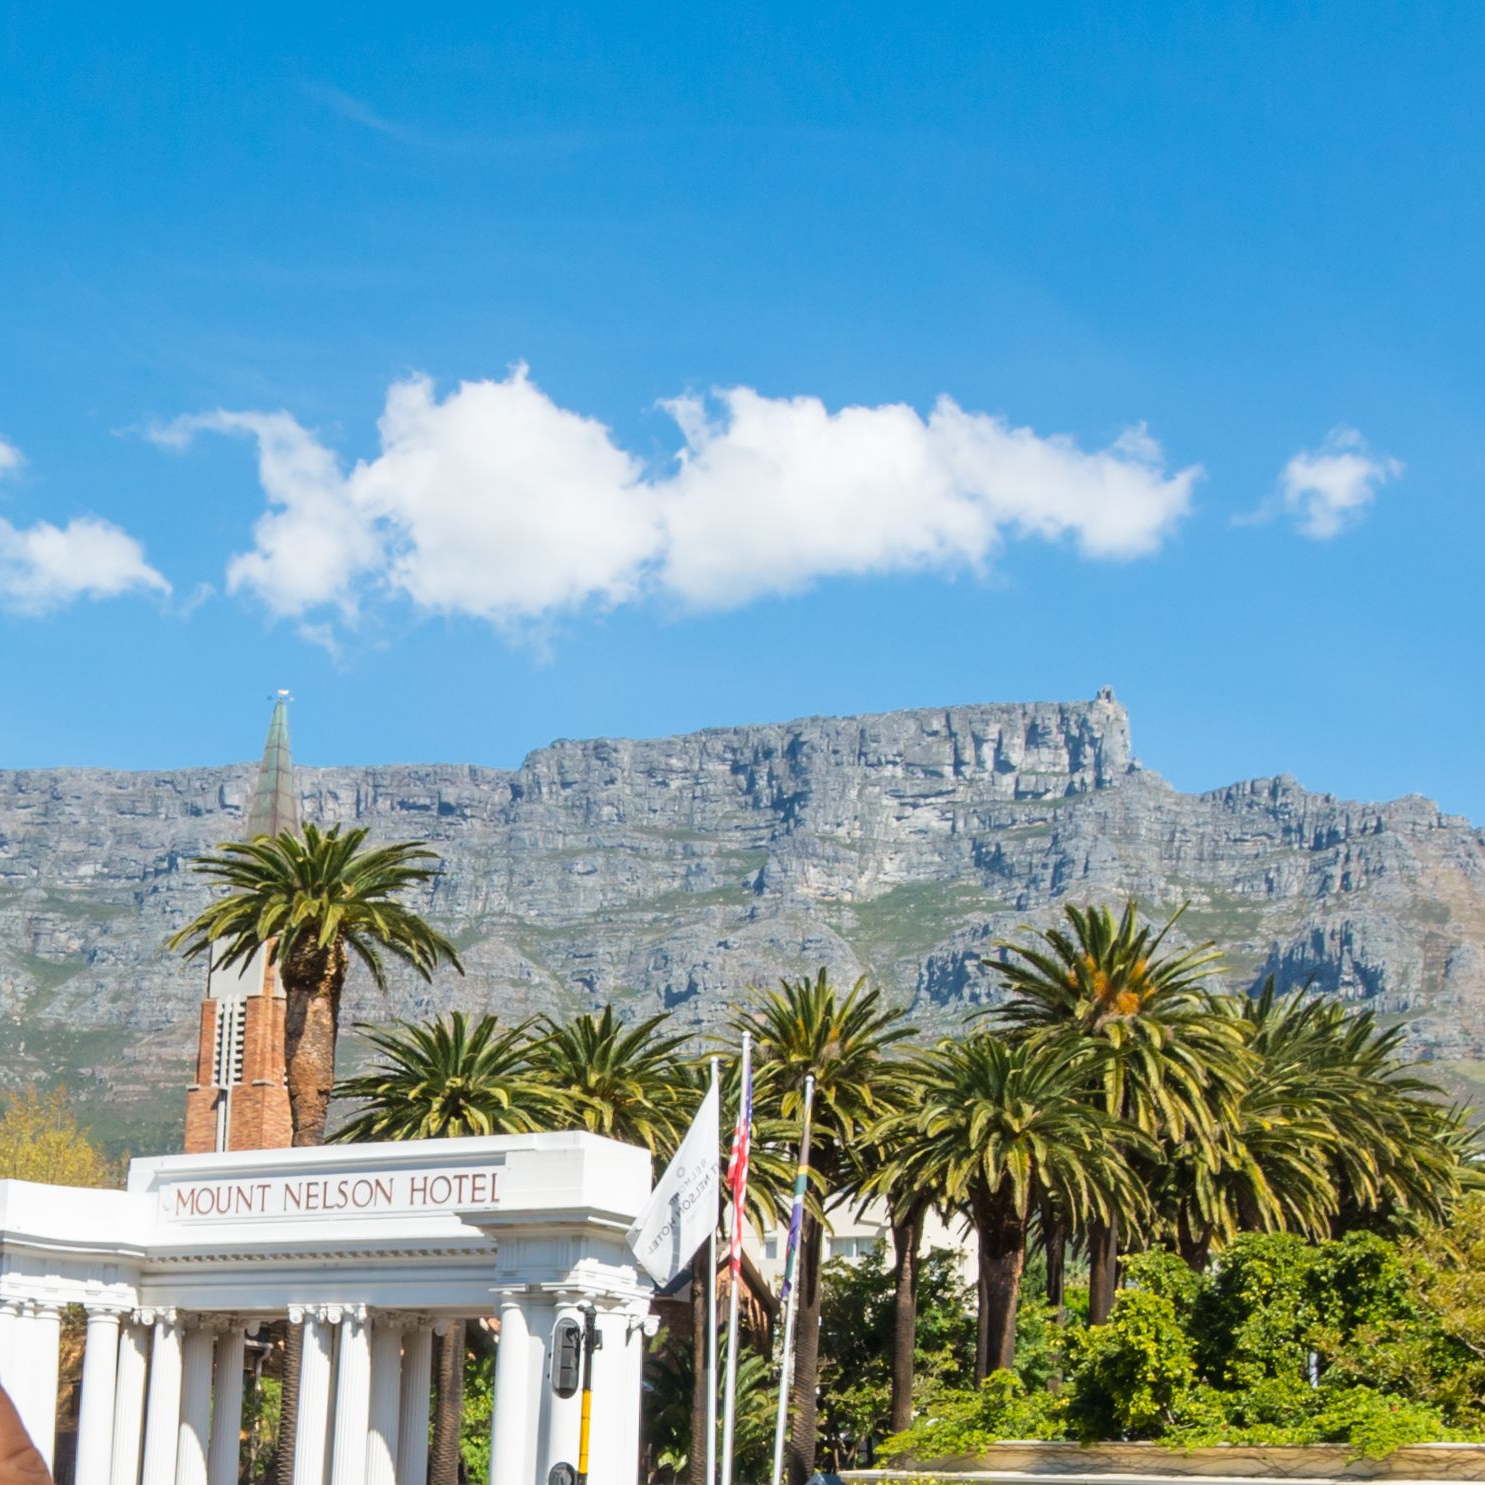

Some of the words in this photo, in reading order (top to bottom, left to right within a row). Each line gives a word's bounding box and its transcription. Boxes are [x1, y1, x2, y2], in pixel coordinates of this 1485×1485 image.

[175, 1183, 271, 1216] MOUNT
[283, 1177, 394, 1211] NELSON
[409, 1172, 500, 1206] HOTEL
